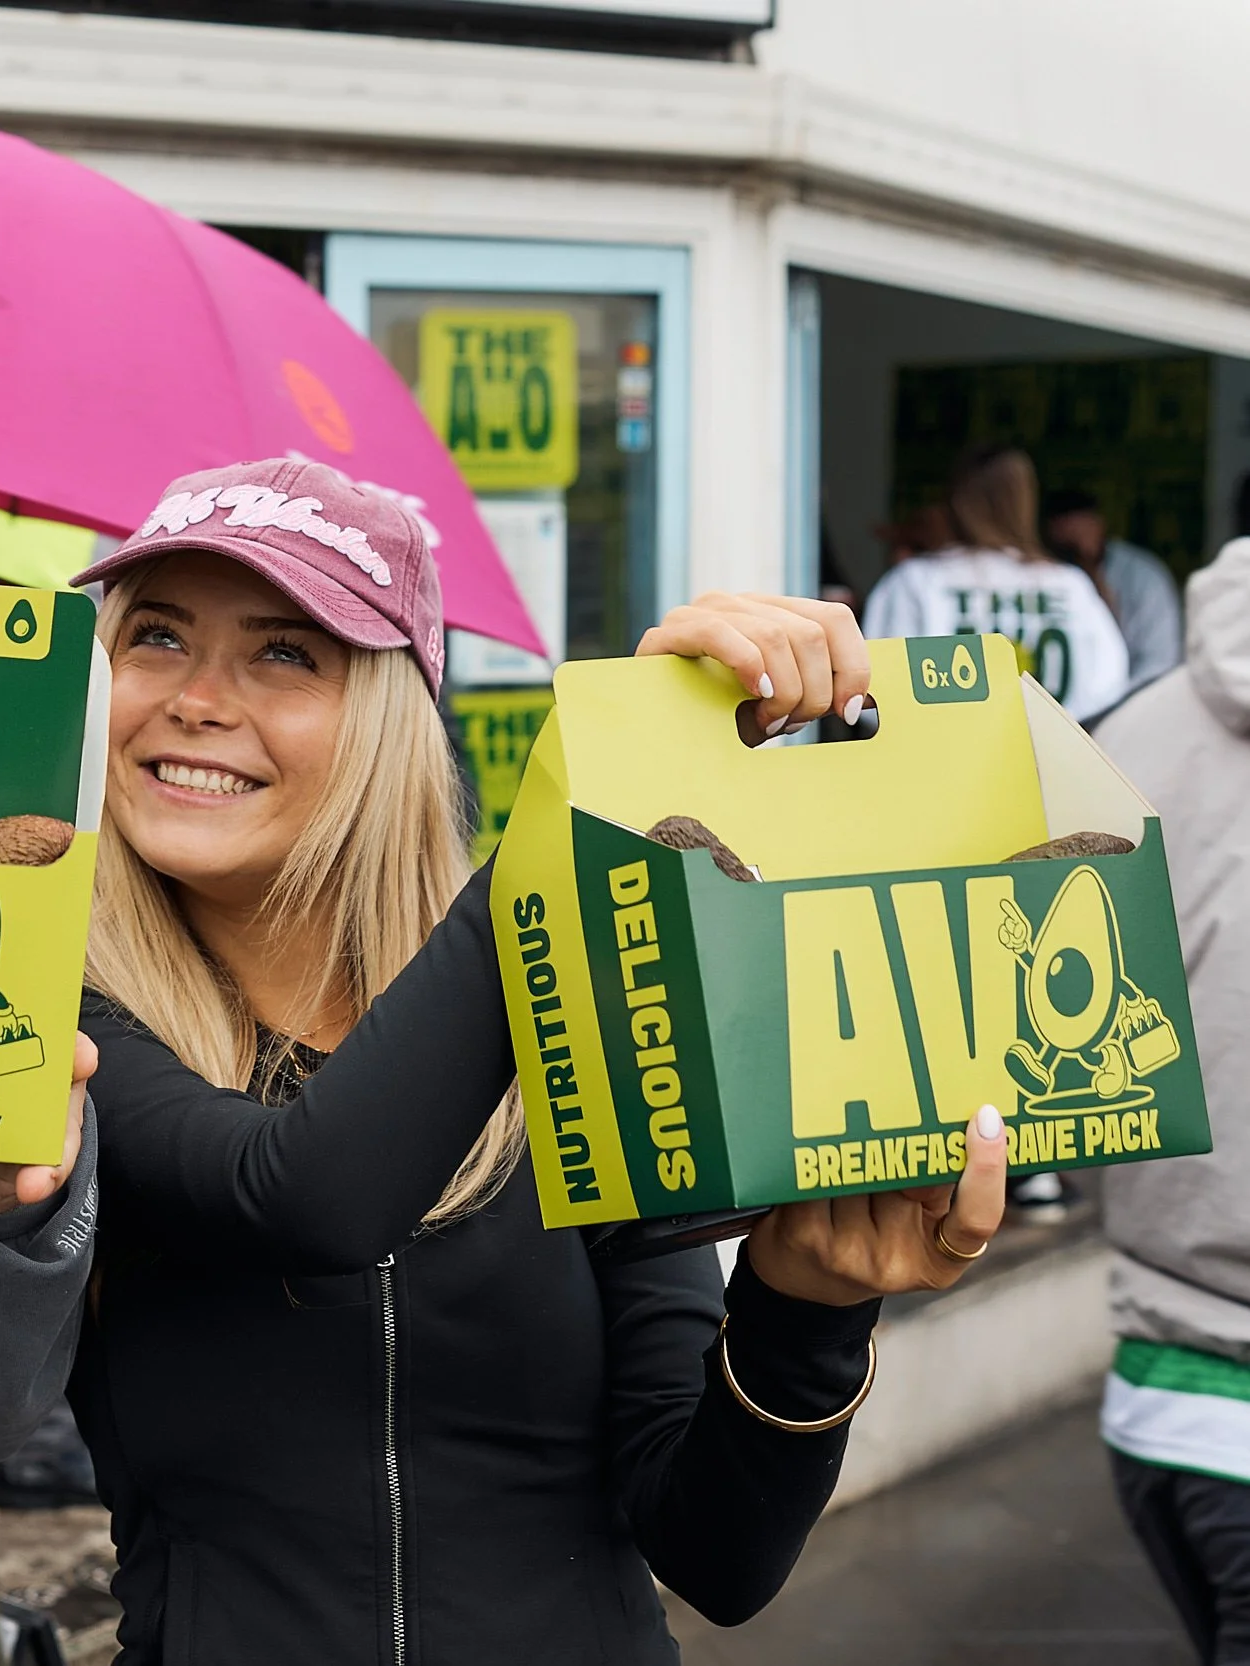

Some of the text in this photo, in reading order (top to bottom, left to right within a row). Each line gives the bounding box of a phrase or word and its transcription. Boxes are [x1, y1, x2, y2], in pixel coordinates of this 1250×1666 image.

[443, 327, 552, 356] THE
[513, 892, 602, 1204] NUTRITIOUS
[607, 860, 697, 1192] DELICIOUS
[793, 1108, 1162, 1191] BREAKFAS RAVE PACK
